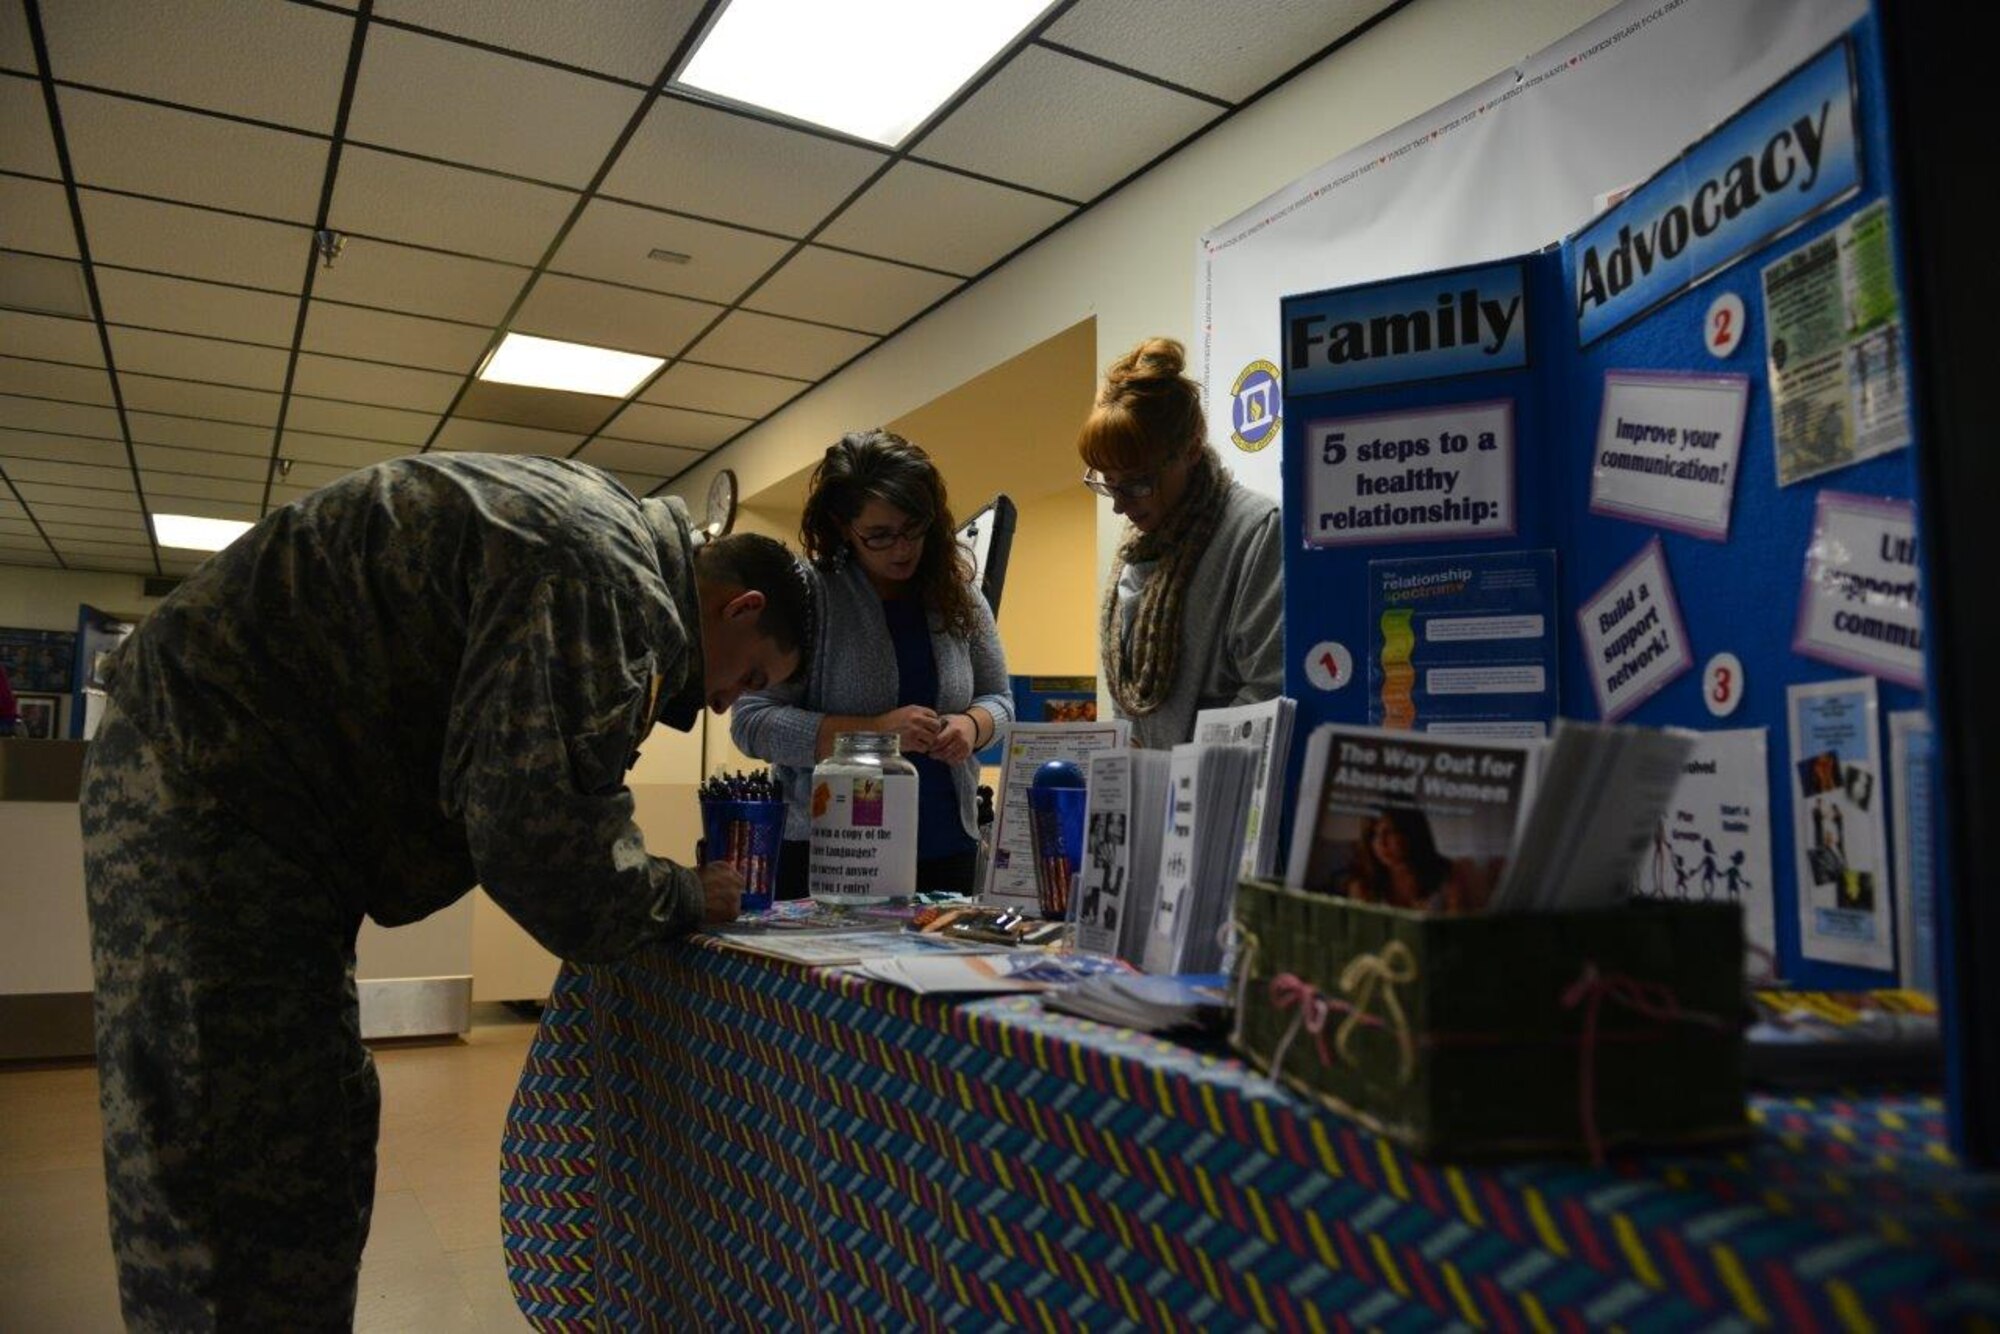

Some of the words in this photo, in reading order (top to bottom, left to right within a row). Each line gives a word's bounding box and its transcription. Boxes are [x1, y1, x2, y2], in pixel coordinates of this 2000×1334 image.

[1664, 0, 1689, 13] PART
[1577, 101, 1829, 319] Advocacy
[1291, 289, 1521, 370] Family
[1714, 309, 1732, 346] 2
[1323, 432, 1346, 465] 5
[1357, 436, 1430, 462] steps
[1440, 431, 1467, 453] to
[1478, 431, 1497, 450] a
[1616, 418, 1677, 445] Improve
[1680, 428, 1721, 450] your
[1357, 467, 1459, 496] healthy
[1601, 450, 1728, 485] communication!
[1320, 497, 1498, 531] relationship:
[1383, 567, 1473, 590] relationship
[1383, 583, 1457, 605] spectrum
[1598, 592, 1636, 635] Build
[1639, 583, 1650, 602] a
[1604, 606, 1660, 663] support
[1607, 630, 1670, 693] network!
[1713, 667, 1732, 703] 3
[1339, 742, 1377, 763] The
[1383, 744, 1428, 772] Way
[1434, 752, 1475, 776] Out
[1480, 754, 1516, 779] for
[1334, 767, 1416, 793] Abused
[1423, 775, 1510, 803] Women
[841, 829, 862, 840] copy
[865, 828, 875, 839] of
[877, 829, 892, 840] the
[843, 883, 870, 894] entry!
[845, 866, 878, 877] answer
